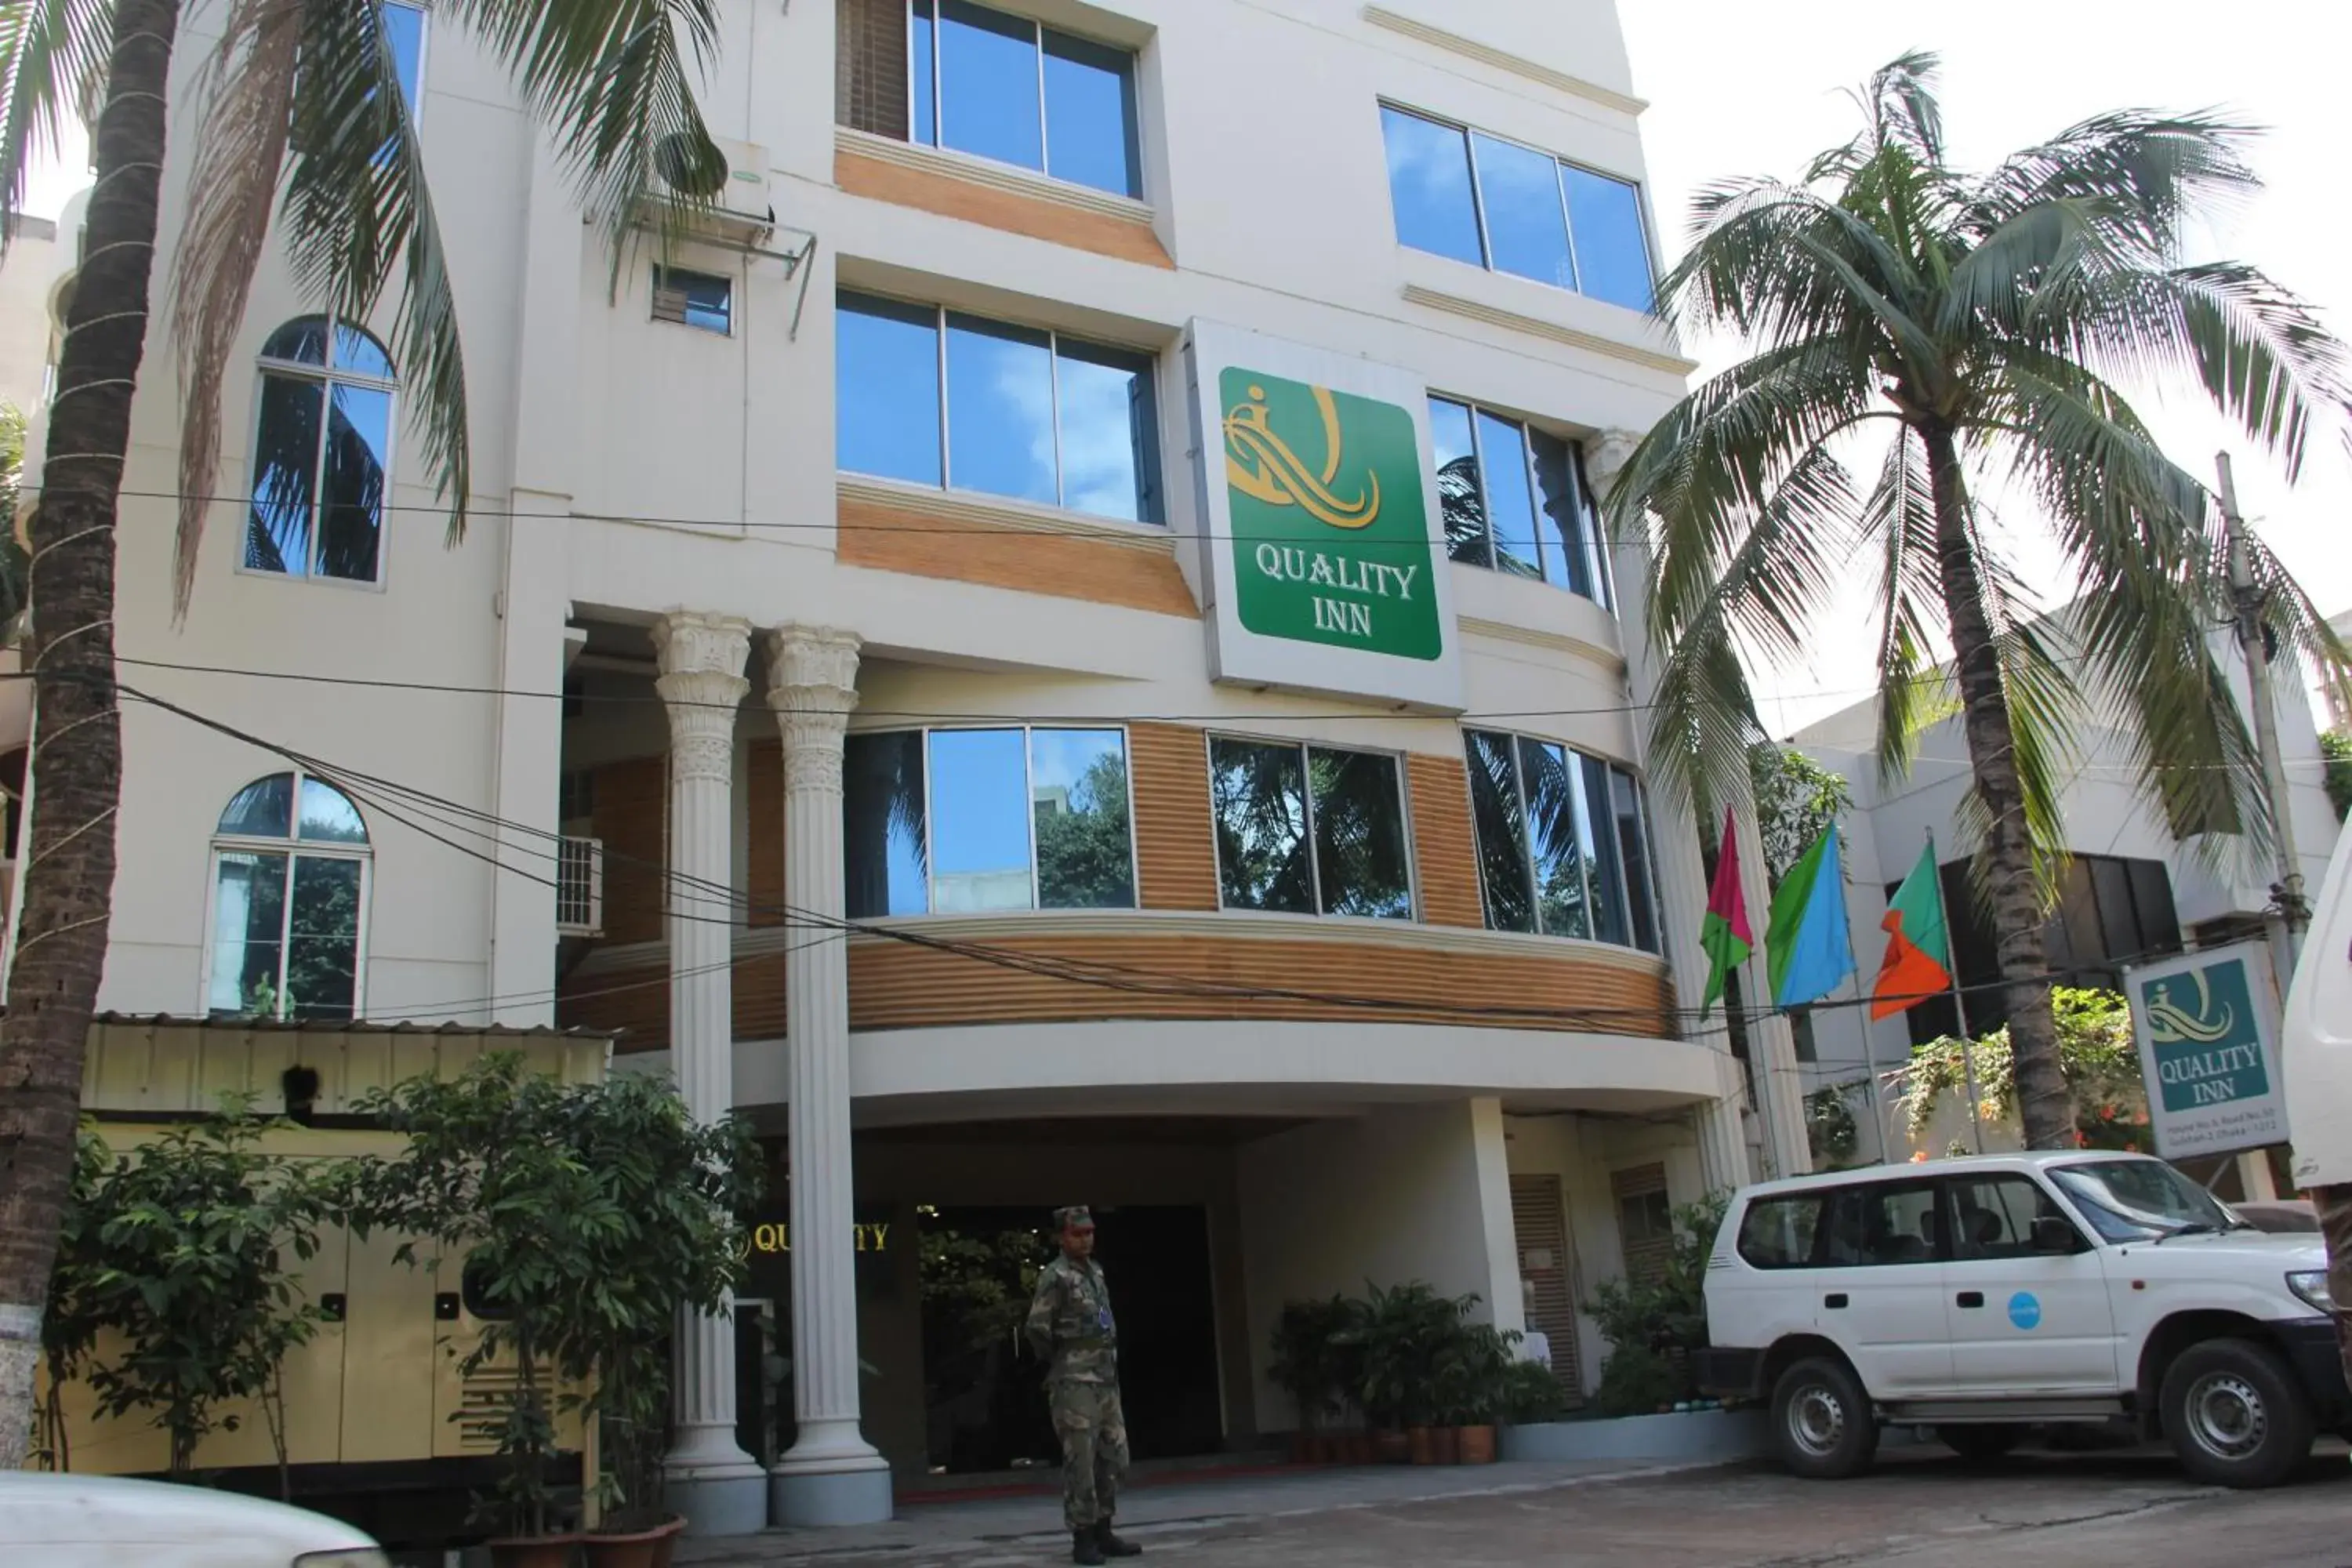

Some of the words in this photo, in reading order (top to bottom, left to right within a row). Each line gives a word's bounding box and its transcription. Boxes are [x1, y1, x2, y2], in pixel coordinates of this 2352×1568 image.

[1256, 543, 1417, 600] QUALITY
[1312, 596, 1372, 637] INN
[2159, 1043, 2257, 1083] QUALITY
[2193, 1078, 2235, 1103] INN
[755, 1224, 889, 1252] QUTY
